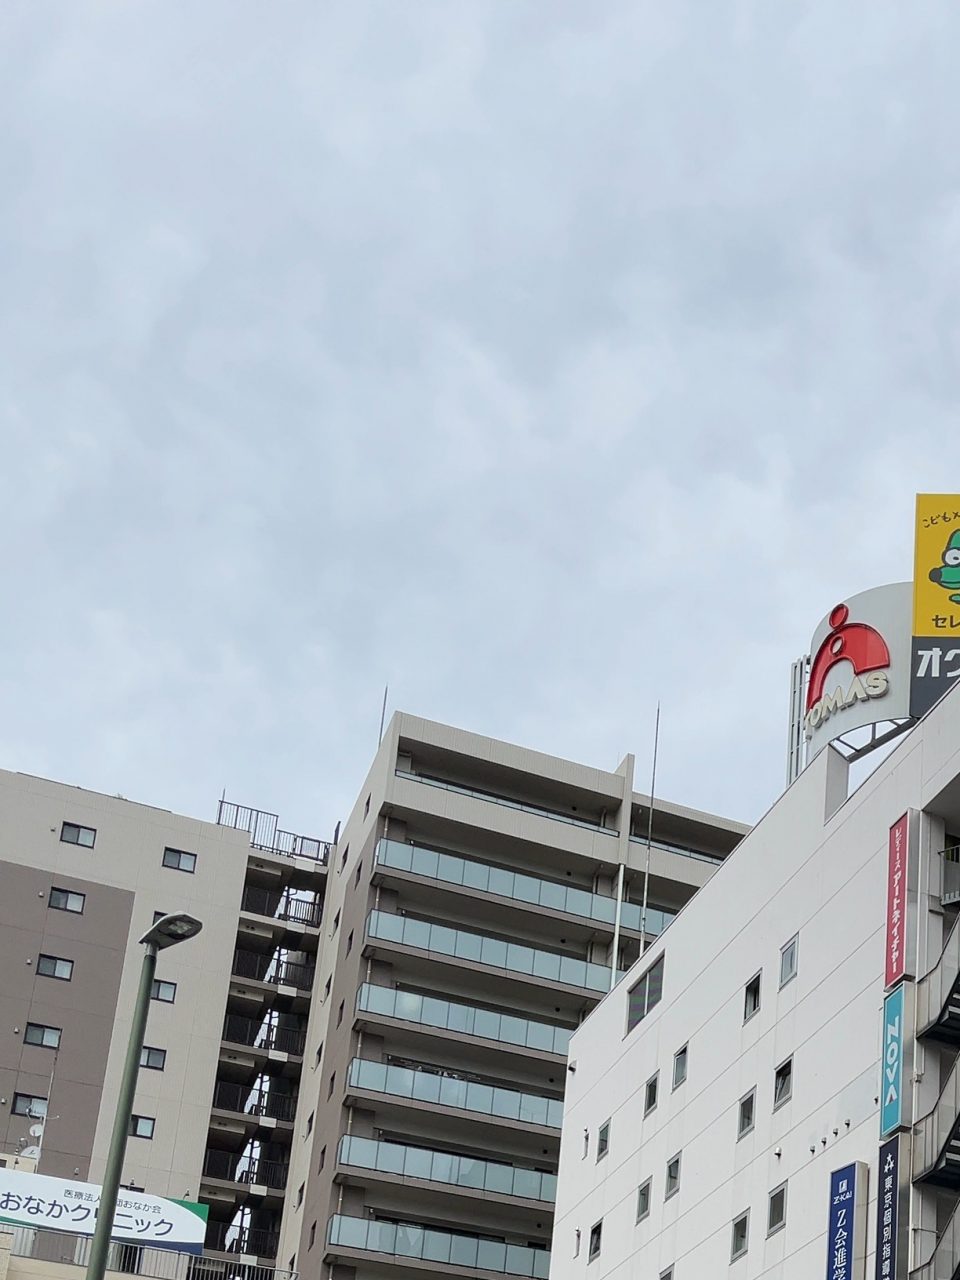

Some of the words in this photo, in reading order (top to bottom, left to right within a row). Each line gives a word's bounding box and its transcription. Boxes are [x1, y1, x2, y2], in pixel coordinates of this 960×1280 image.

[885, 1018, 899, 1106] NOVA
[63, 1189, 162, 1214] 医療法人団おなか会
